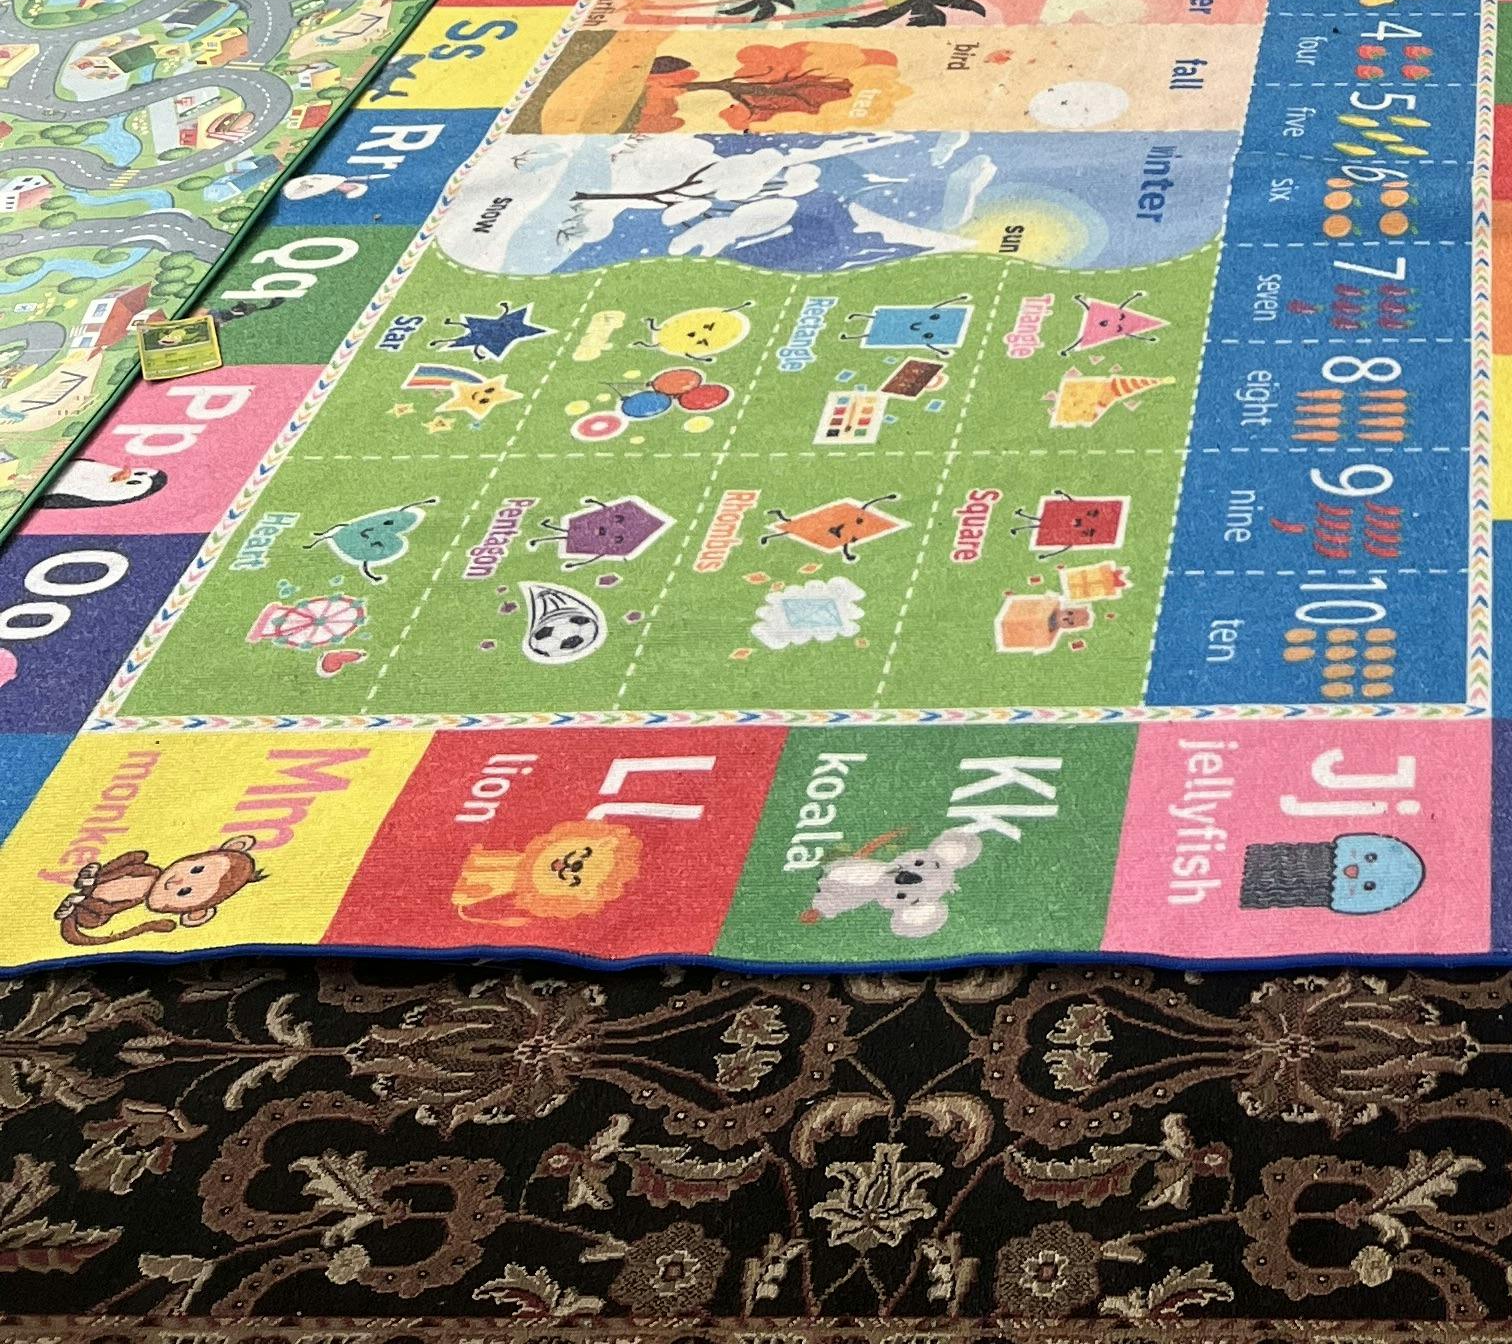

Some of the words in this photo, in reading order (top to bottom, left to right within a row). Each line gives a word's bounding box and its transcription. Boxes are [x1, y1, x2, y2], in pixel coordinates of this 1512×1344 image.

[428, 18, 518, 62] Ss
[1295, 35, 1328, 66] four
[1360, 20, 1423, 41] 4
[945, 41, 980, 71] bird
[1169, 57, 1208, 91] fall
[1283, 106, 1317, 138] five
[1349, 90, 1417, 112] 5
[346, 123, 442, 170] Rr
[1136, 145, 1184, 224] winter
[1269, 178, 1295, 204] six
[1341, 162, 1410, 183] 6
[473, 196, 512, 234] snow
[999, 224, 1026, 254] sun
[220, 236, 360, 300] Qq
[1333, 257, 1407, 281] 7
[1252, 273, 1282, 322] seven
[379, 315, 424, 351] Star
[1004, 295, 1052, 358] Triangle
[1321, 355, 1402, 383] 8
[112, 384, 257, 458] Pp
[1234, 368, 1281, 428] eight
[1310, 464, 1395, 497] 9
[465, 498, 539, 580] Pentagon
[695, 491, 759, 570] Rhombus
[951, 489, 1000, 563] Square
[1224, 488, 1256, 543] nine
[232, 513, 298, 569] Heart
[1295, 576, 1388, 625] 10
[1206, 618, 1245, 663] ten
[220, 748, 372, 852] Mm
[454, 753, 538, 823] lion
[586, 756, 716, 820] Ll
[946, 757, 1063, 843] Kk
[1281, 748, 1420, 820] Jj
[36, 750, 161, 886] monkey
[783, 752, 867, 872] koala
[1168, 738, 1239, 905] jellyfish
